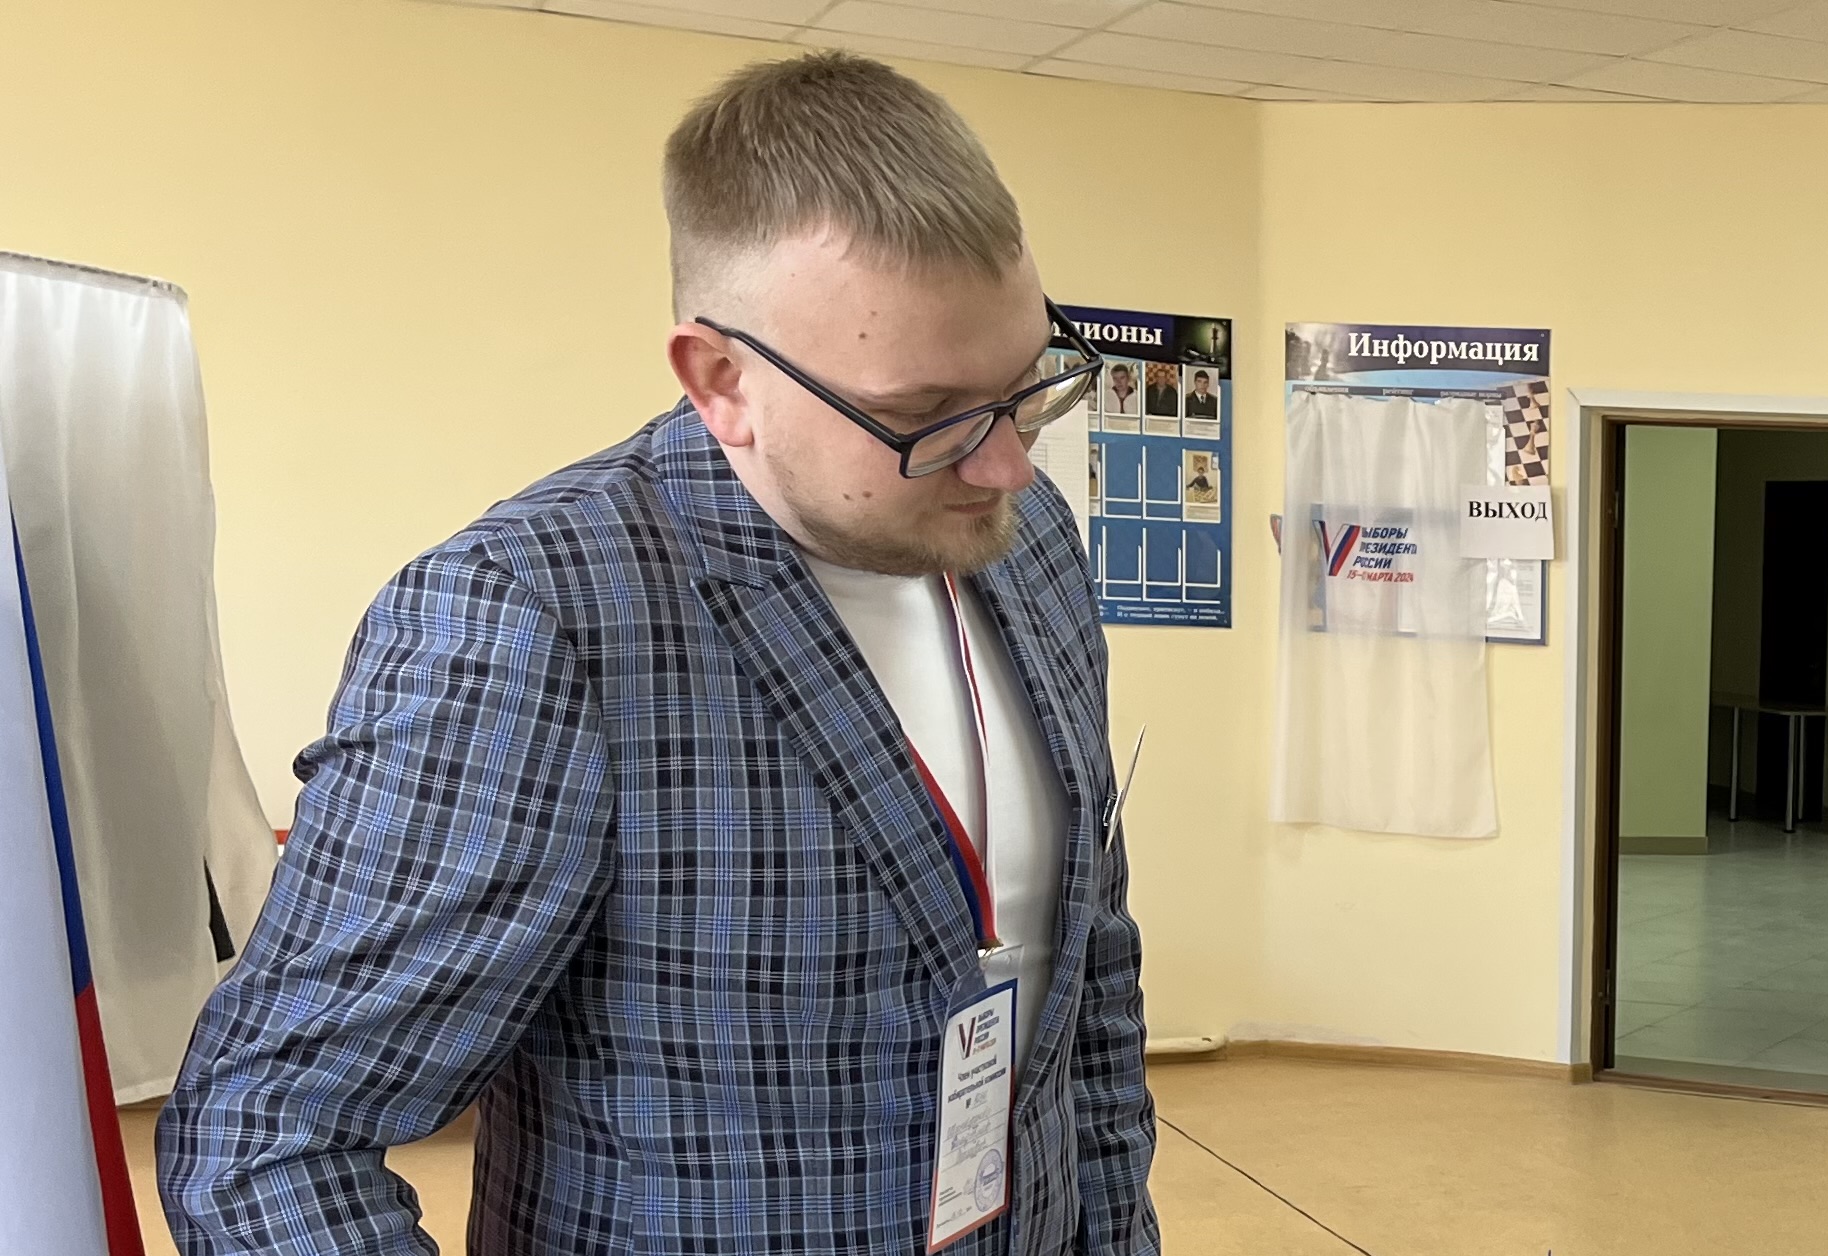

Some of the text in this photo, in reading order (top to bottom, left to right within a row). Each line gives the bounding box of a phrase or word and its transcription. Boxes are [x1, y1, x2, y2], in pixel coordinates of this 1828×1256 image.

[1051, 320, 1163, 346] ионы
[1347, 332, 1540, 366] Информация
[1468, 500, 1548, 522] ВЫХОД
[1361, 527, 1408, 539] ЫБОРЫ
[1359, 541, 1417, 555] ЕЗИДЕН
[1353, 556, 1392, 569] РСИИ
